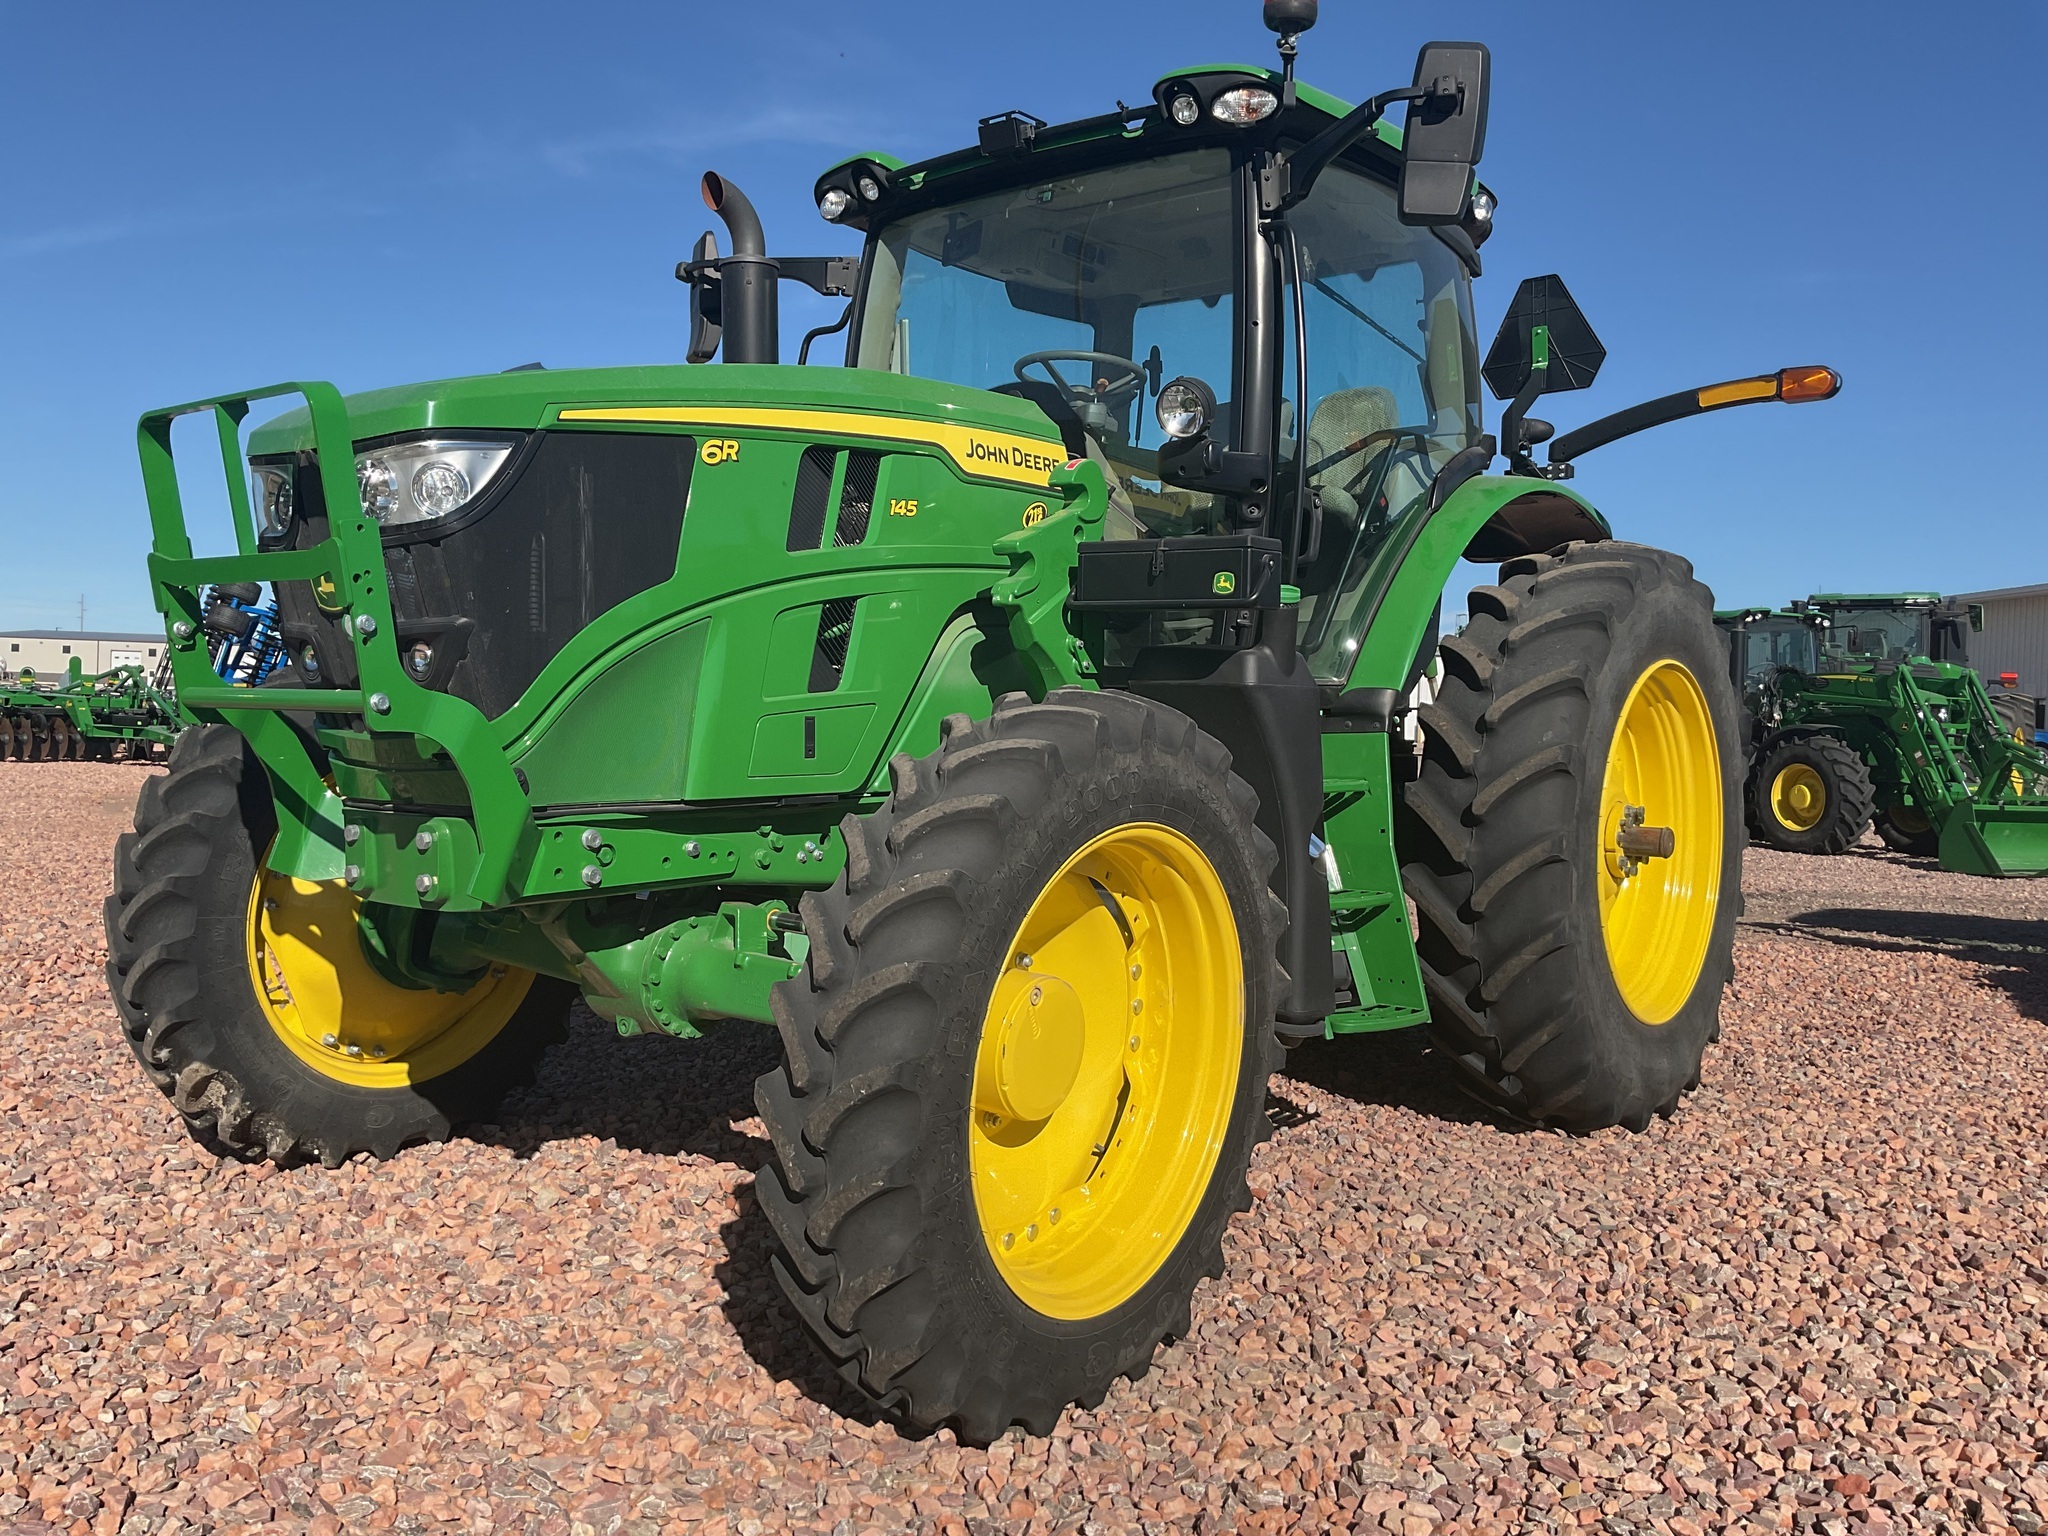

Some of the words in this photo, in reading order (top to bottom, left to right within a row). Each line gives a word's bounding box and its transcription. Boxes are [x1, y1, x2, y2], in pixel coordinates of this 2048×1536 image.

[701, 439, 740, 466] 6R
[966, 438, 1009, 465] JOHN
[889, 499, 918, 518] 145
